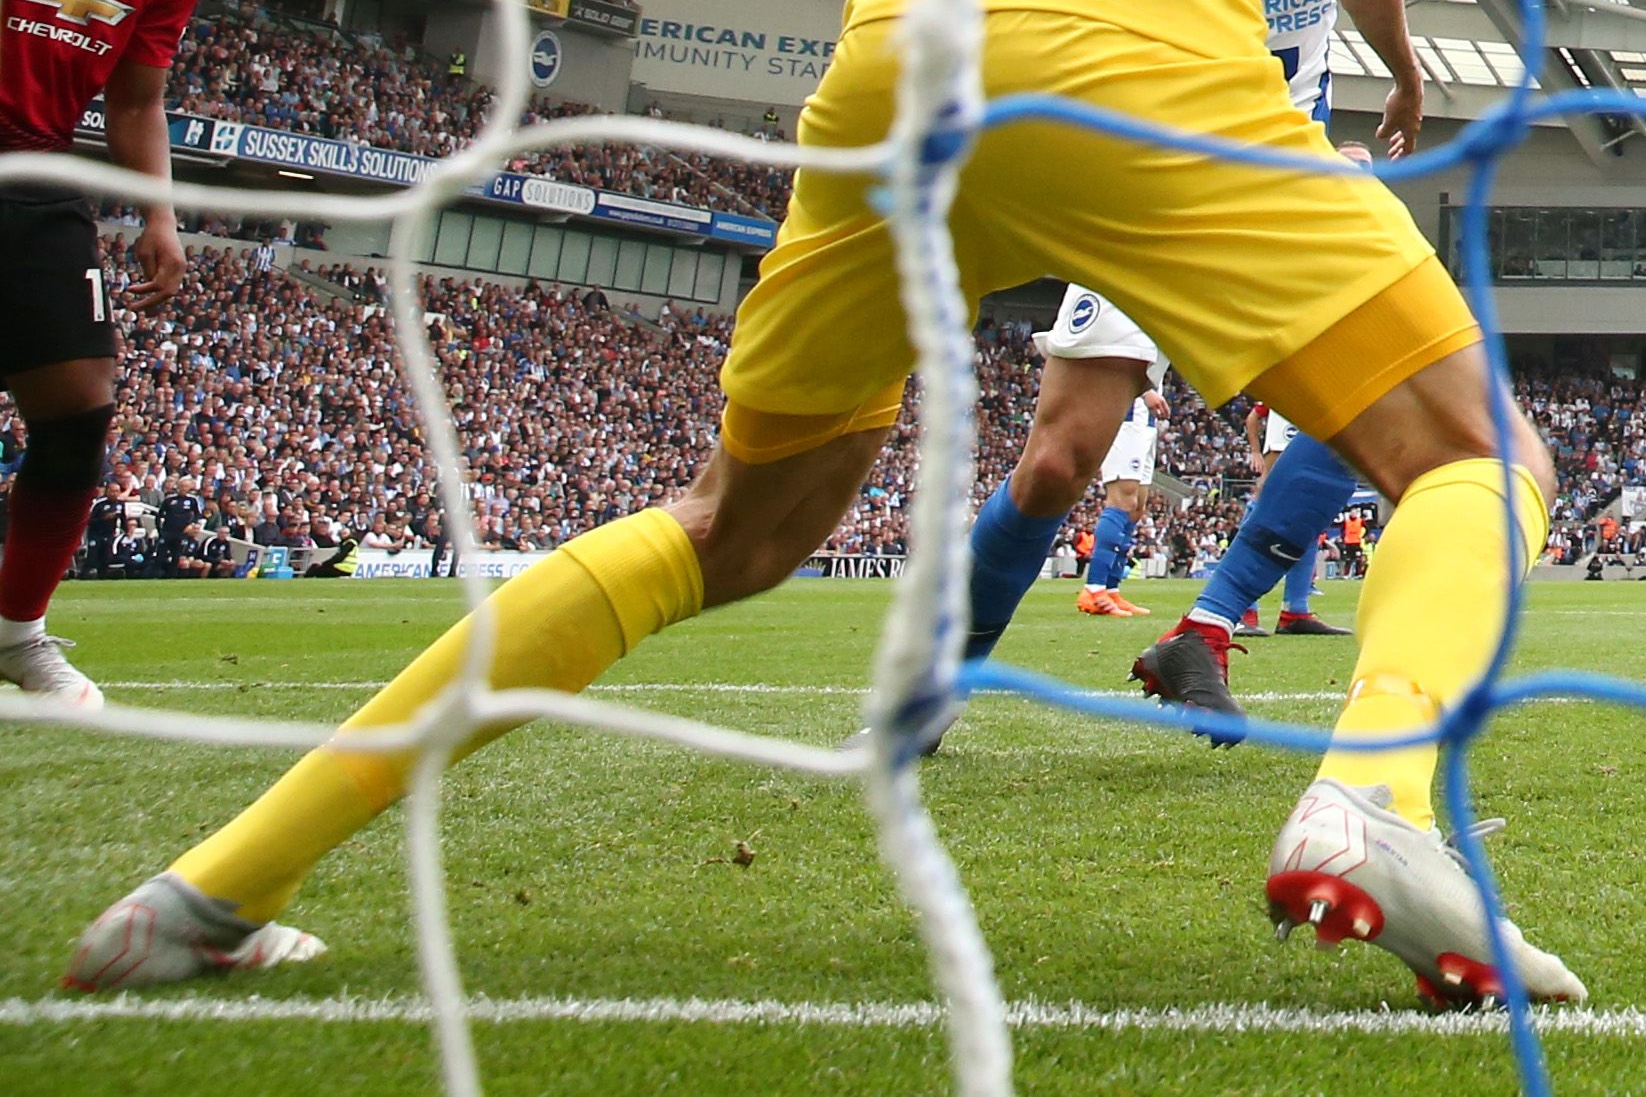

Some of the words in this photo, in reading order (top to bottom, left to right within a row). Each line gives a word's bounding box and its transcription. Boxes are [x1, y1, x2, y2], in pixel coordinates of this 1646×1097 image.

[7, 16, 113, 56] CHEVROLET
[245, 130, 309, 164] SUSSEX
[308, 141, 360, 173] SKILLS
[493, 176, 521, 199] GAP
[525, 181, 593, 210] SOLUTIONS
[831, 558, 886, 578] JAMES
